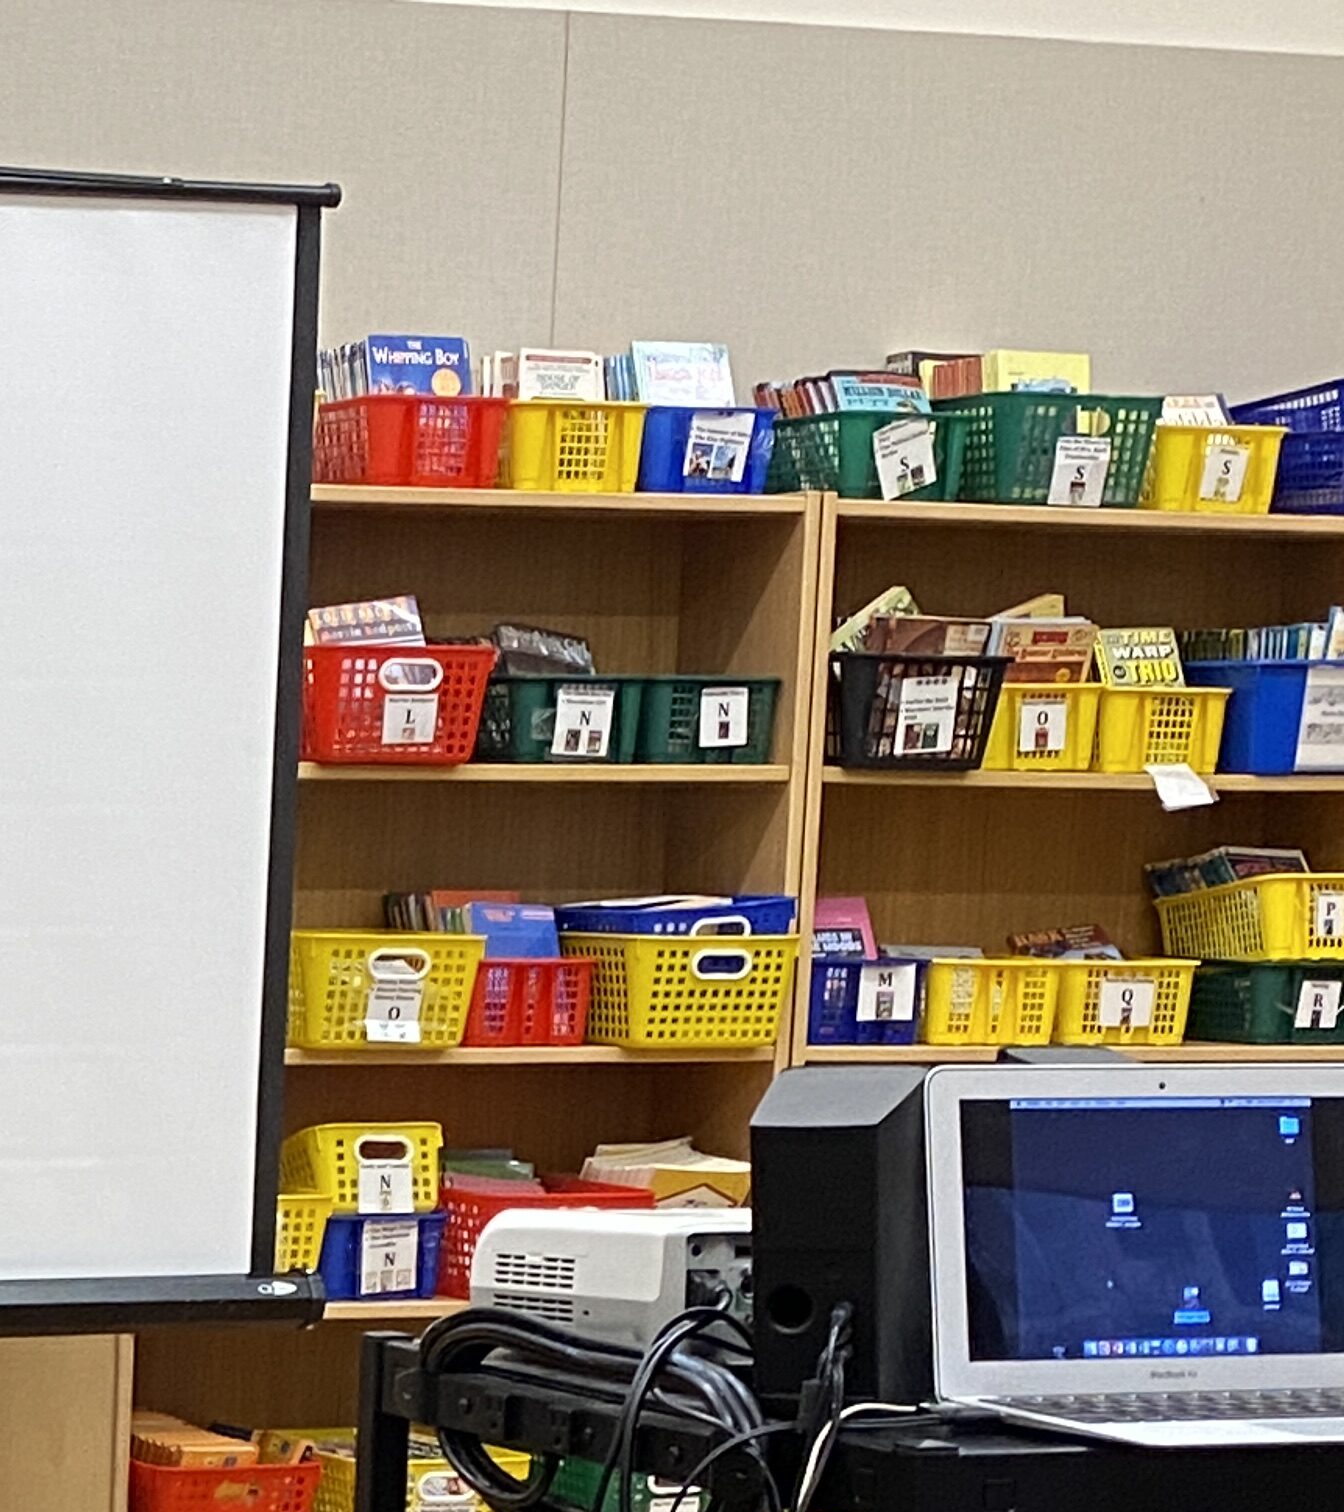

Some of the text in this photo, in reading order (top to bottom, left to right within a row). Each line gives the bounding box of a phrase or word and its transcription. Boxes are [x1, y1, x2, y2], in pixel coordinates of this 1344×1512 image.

[372, 346, 459, 365] WHIPPING BOY
[900, 457, 910, 472] S
[1222, 460, 1232, 475] S
[1075, 465, 1085, 480] S
[1119, 631, 1172, 644] TIME
[1112, 645, 1173, 659] WARP
[1126, 659, 1178, 683] TRIO
[405, 709, 415, 724] L
[719, 702, 730, 717] N
[580, 711, 592, 726] N
[1326, 902, 1336, 917] P
[878, 972, 893, 987] M
[1121, 988, 1134, 1006] Q
[1313, 993, 1324, 1007] R
[380, 1174, 391, 1190] N
[384, 1252, 396, 1267] N
